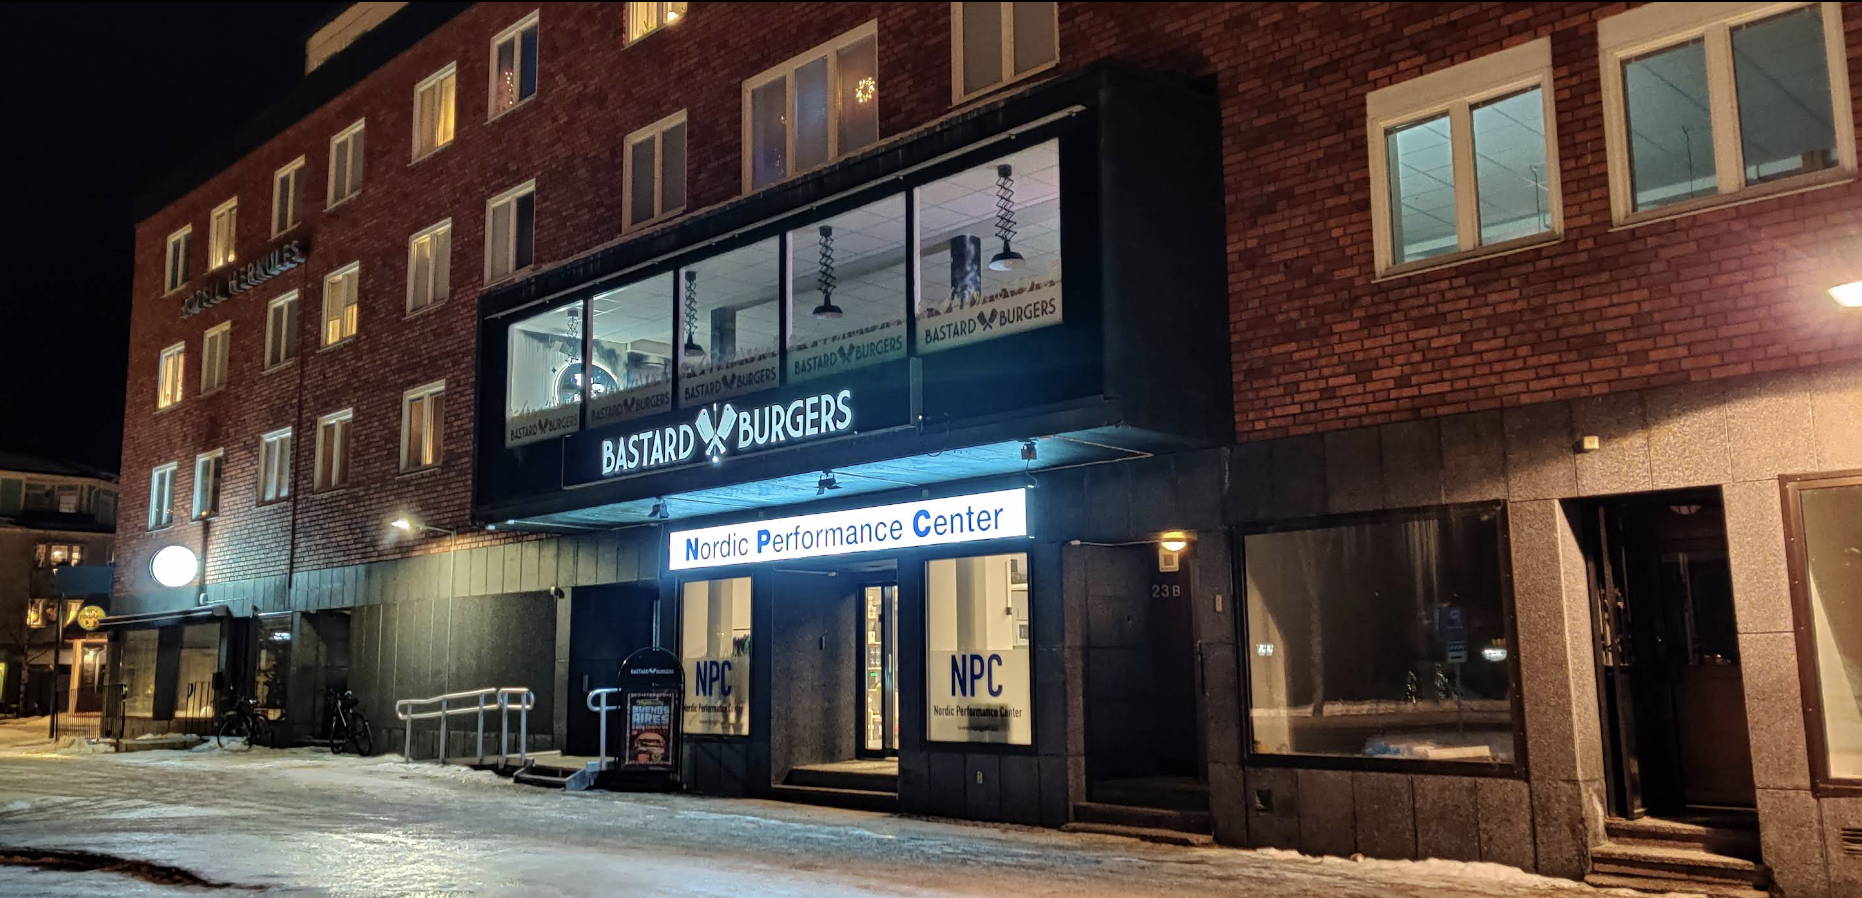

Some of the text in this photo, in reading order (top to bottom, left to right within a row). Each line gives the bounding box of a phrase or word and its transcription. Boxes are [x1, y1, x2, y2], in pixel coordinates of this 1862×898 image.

[925, 298, 1056, 344] BASTARD BURGERS
[794, 336, 903, 375] BASTARD BURGERS
[684, 367, 776, 401] BASTARD BURGERS
[591, 392, 669, 422] BASTARD BURGERS
[510, 415, 578, 441] BASTARD BURGERS
[601, 389, 852, 475] BASTARD BURGERS
[685, 506, 1004, 562] Nordic Performance Center
[1152, 584, 1181, 598] 23 B
[695, 660, 732, 697] NPC
[951, 653, 1003, 698] NPC
[632, 705, 669, 715] BUENOS
[632, 713, 669, 724] AIRES
[933, 704, 1023, 718] Nordic Performance Center
